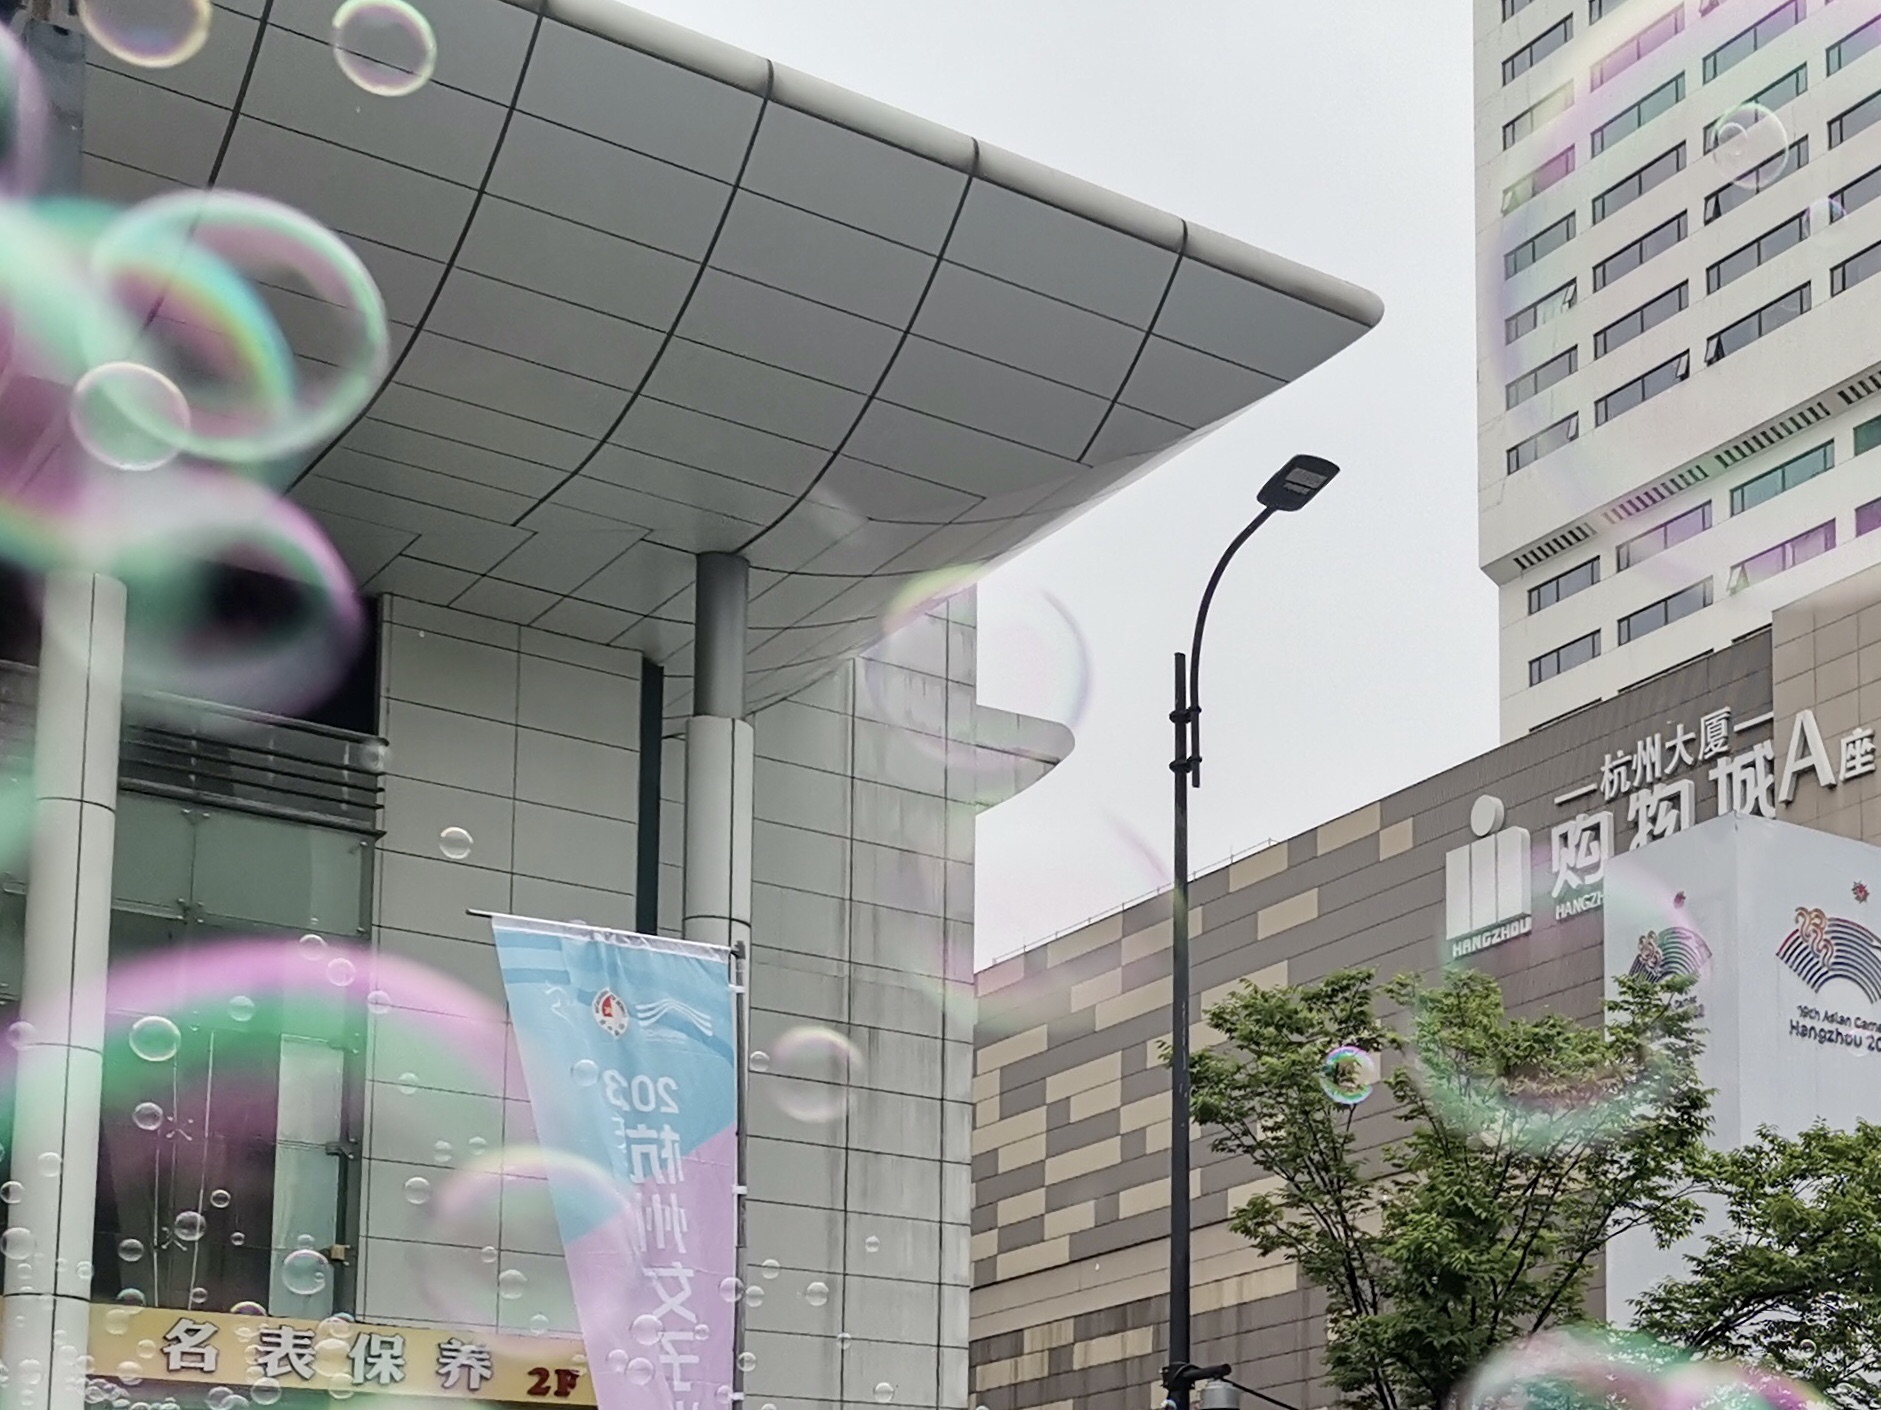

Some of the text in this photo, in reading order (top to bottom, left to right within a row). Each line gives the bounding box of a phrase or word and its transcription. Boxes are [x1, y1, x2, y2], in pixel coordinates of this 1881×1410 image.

[1600, 706, 1732, 801] 杭州大厦
[1452, 916, 1532, 958] HANGZHOU
[1789, 1018, 1862, 1049] Hangzhou
[1823, 1009, 1851, 1027] Asian
[162, 1316, 581, 1398] 名表保养 2F
